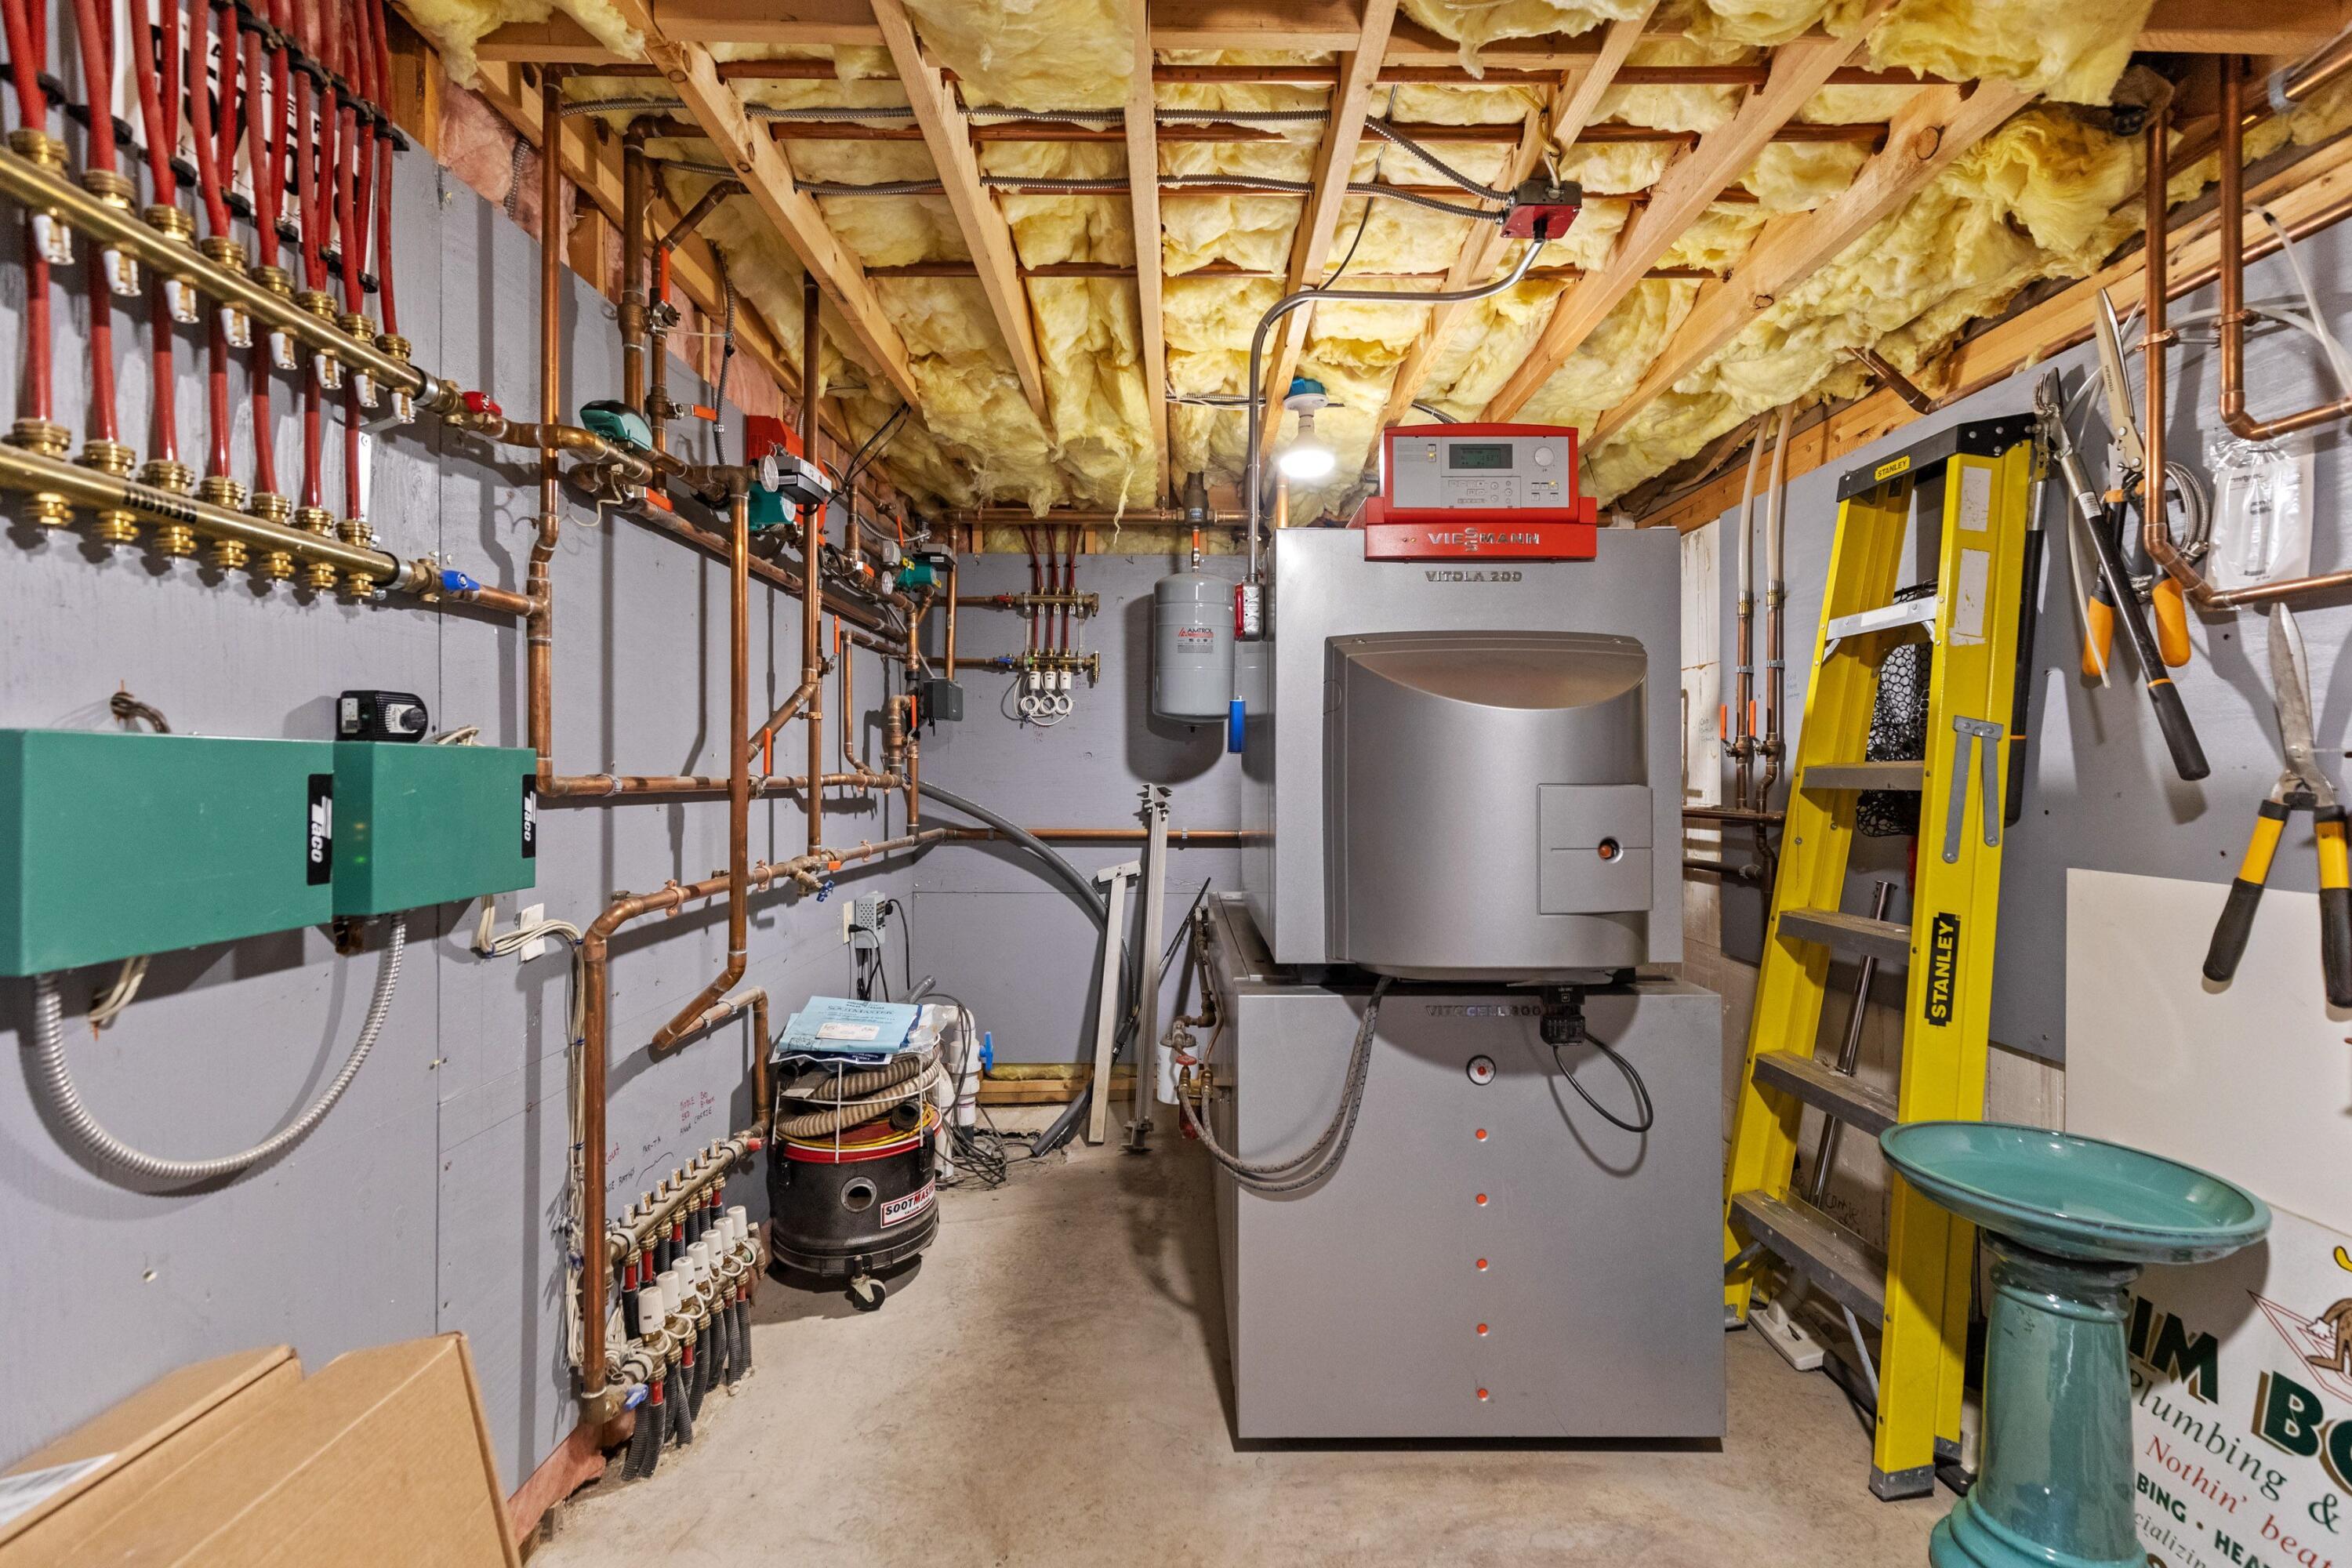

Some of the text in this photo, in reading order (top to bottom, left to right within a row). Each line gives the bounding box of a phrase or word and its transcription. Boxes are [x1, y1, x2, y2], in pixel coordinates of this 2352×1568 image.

[1878, 459, 1907, 477] STANLEY
[1428, 527, 1540, 552] VIESSMANN
[1425, 571, 1523, 582] VITOLA 200
[311, 795, 332, 863] Taco
[524, 790, 536, 841] Taco
[1931, 920, 1954, 1018] STANLEY
[2122, 1287, 2219, 1406] IM
[2136, 1472, 2272, 1568] BING HEA
[2308, 1493, 2342, 1534] &
